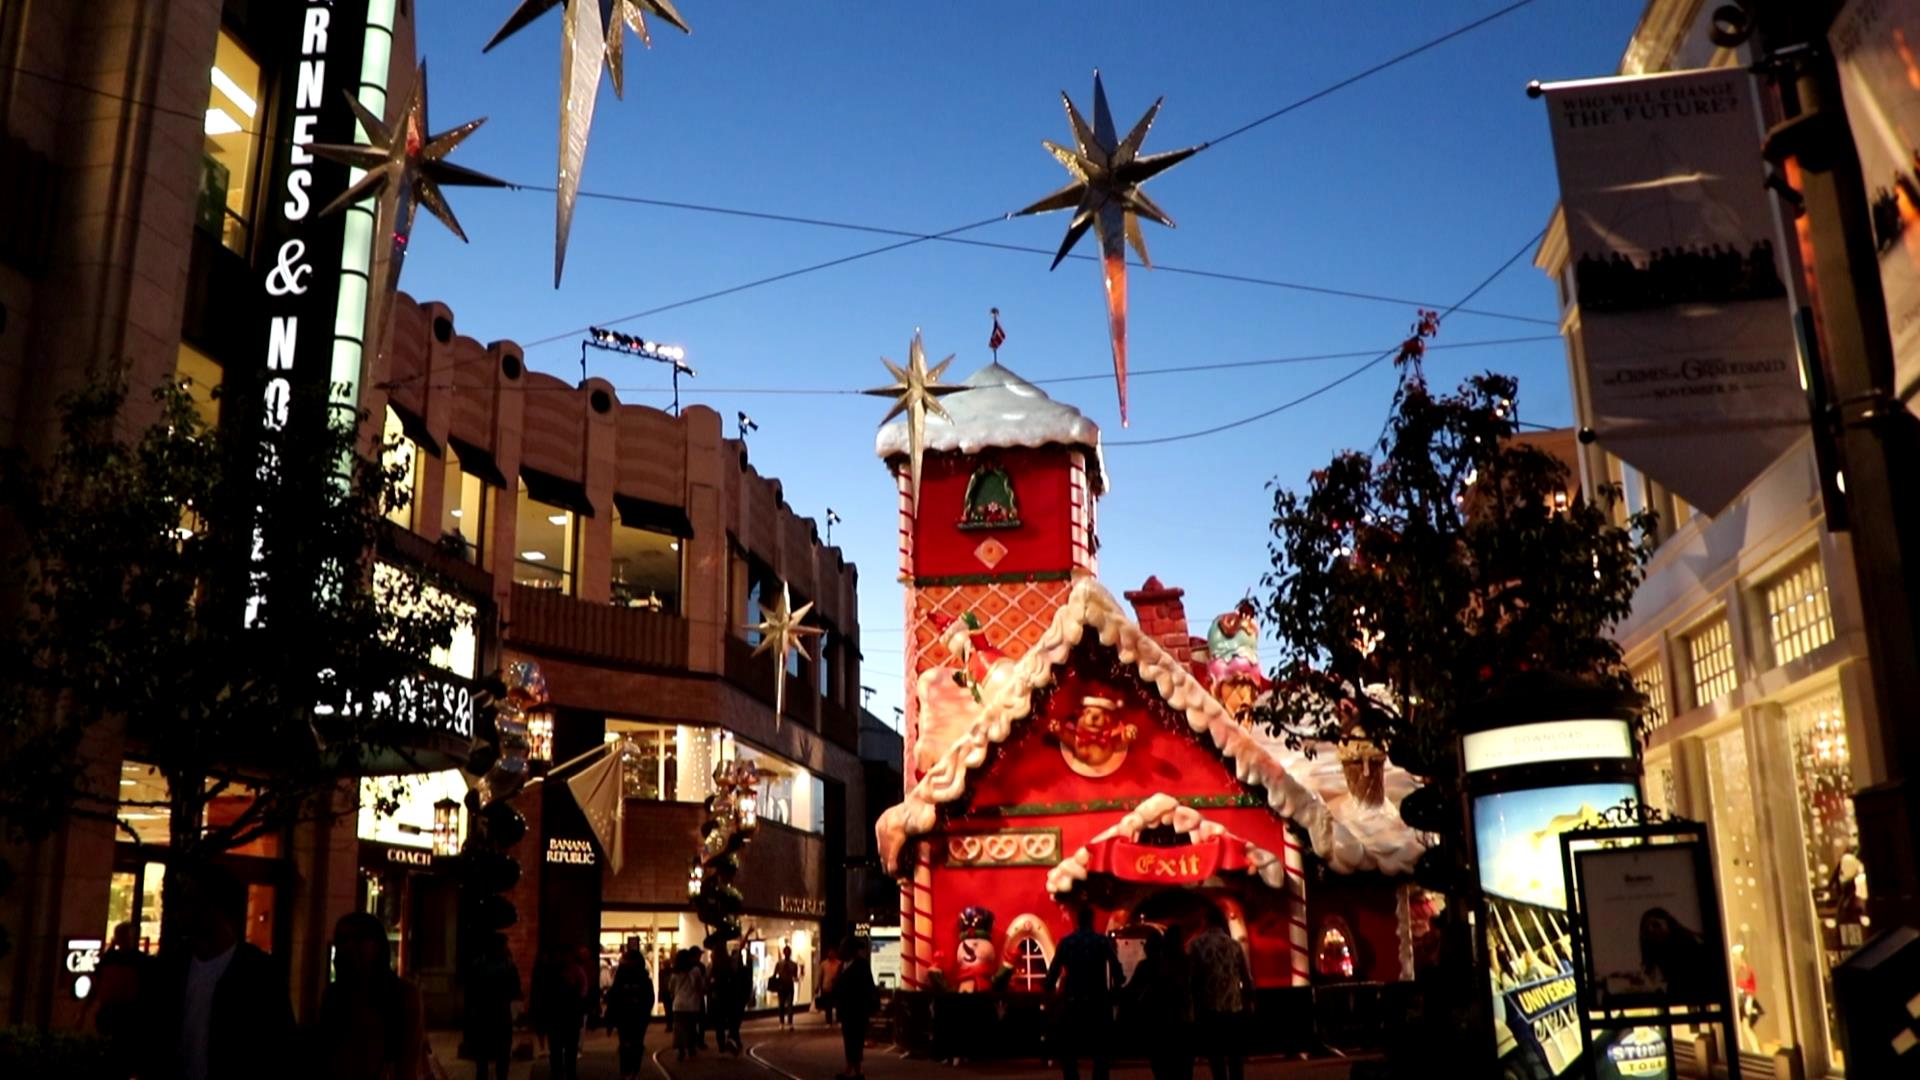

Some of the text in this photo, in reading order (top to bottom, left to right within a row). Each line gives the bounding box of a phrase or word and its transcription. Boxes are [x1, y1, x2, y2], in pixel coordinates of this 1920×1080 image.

[1562, 83, 1736, 111] WHO WILL CHANGE
[1564, 96, 1739, 129] THE FUTURE?
[265, 238, 313, 297] &
[454, 685, 472, 738] &
[386, 848, 432, 866] COACH
[546, 849, 595, 865] REPUBLIC
[549, 838, 592, 852] BANANA
[1135, 853, 1200, 877] Exit
[1517, 976, 1577, 1014] UNIVERSA
[1628, 1059, 1664, 1072] TOUR
